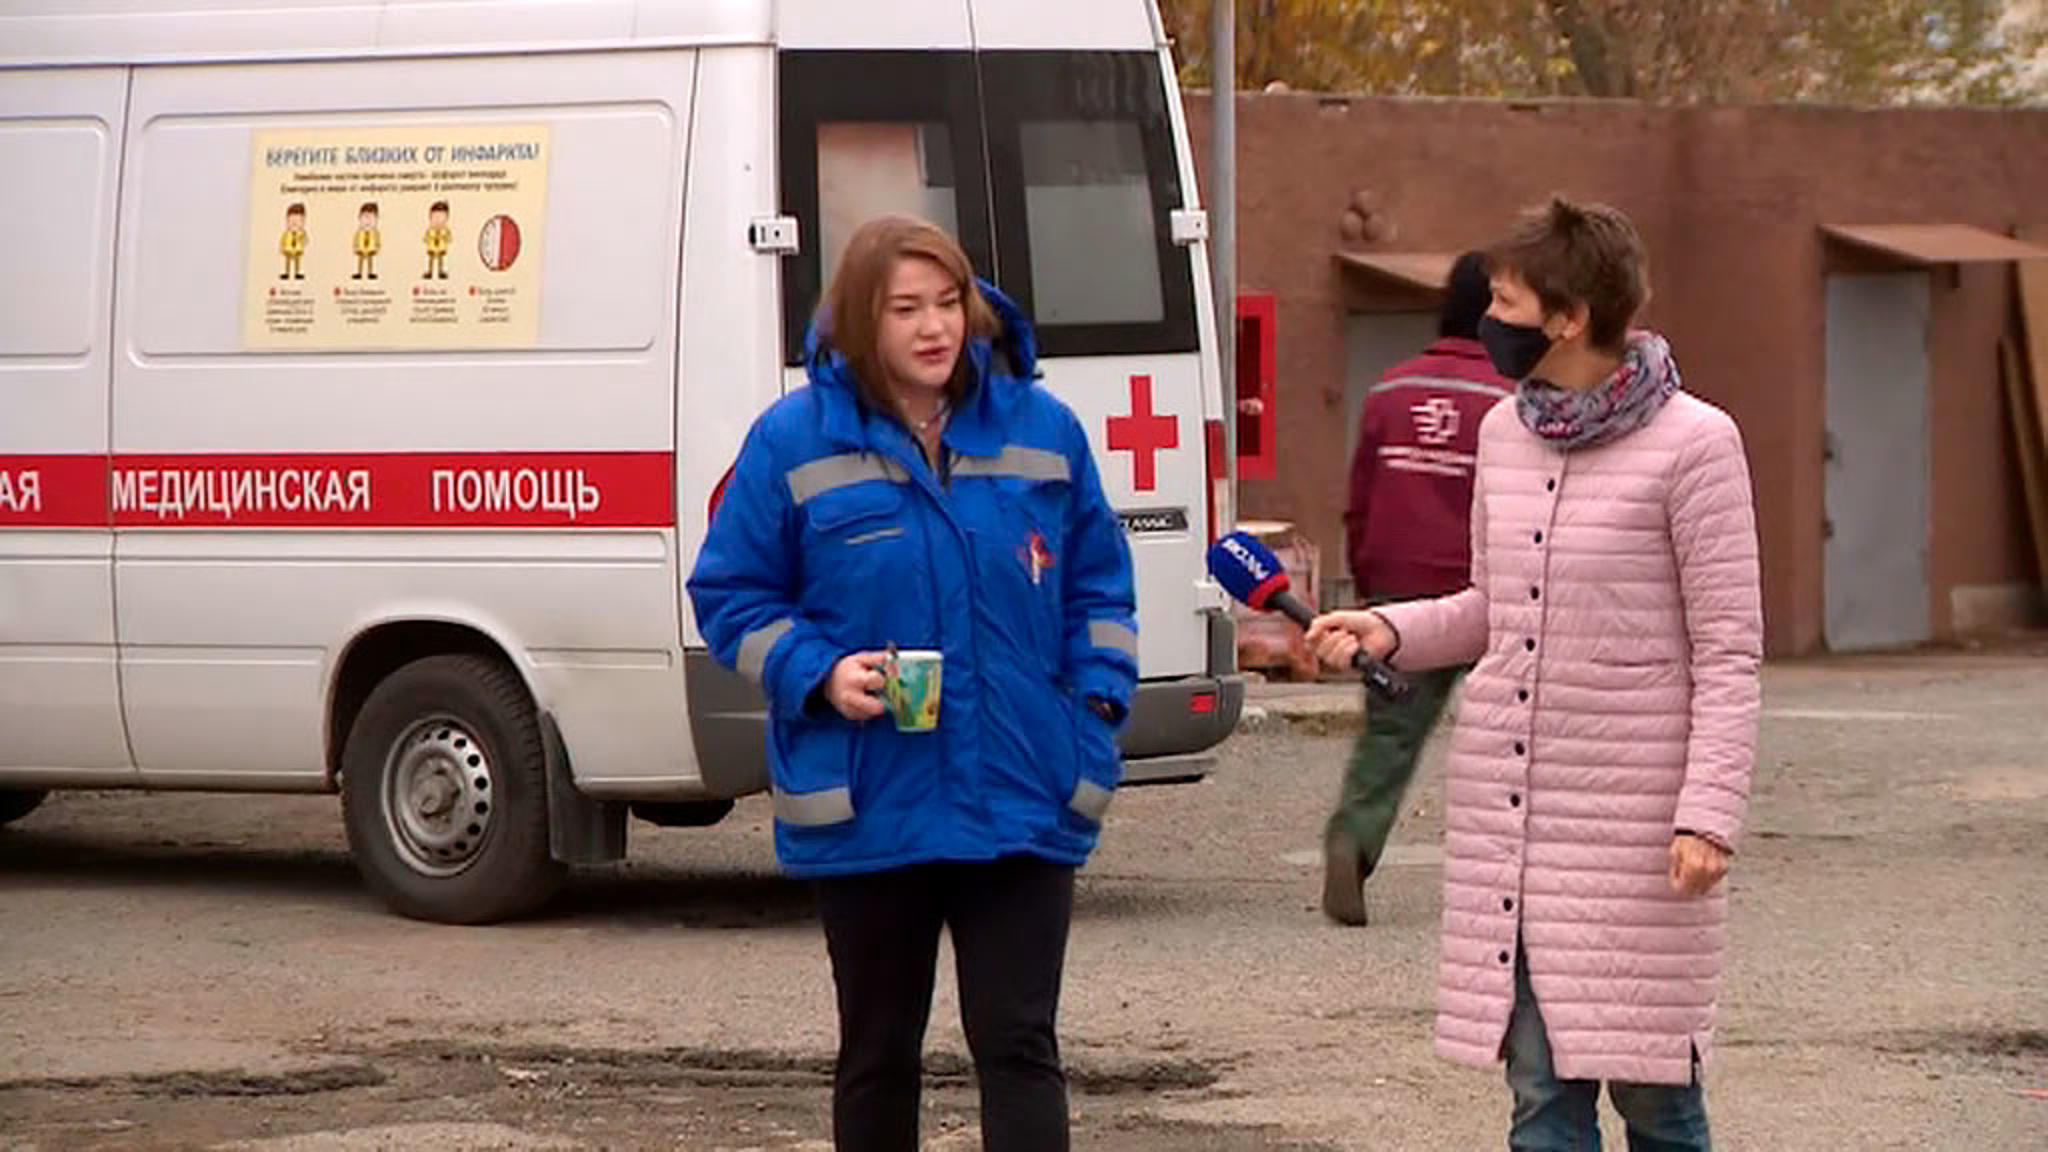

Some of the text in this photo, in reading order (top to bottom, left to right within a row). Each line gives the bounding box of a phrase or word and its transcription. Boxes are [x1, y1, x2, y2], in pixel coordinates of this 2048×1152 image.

[424, 145, 444, 164] ОТ
[112, 469, 371, 519] МЕДИЦИНСКАЯ
[432, 468, 600, 520] ПОМОЩЬ
